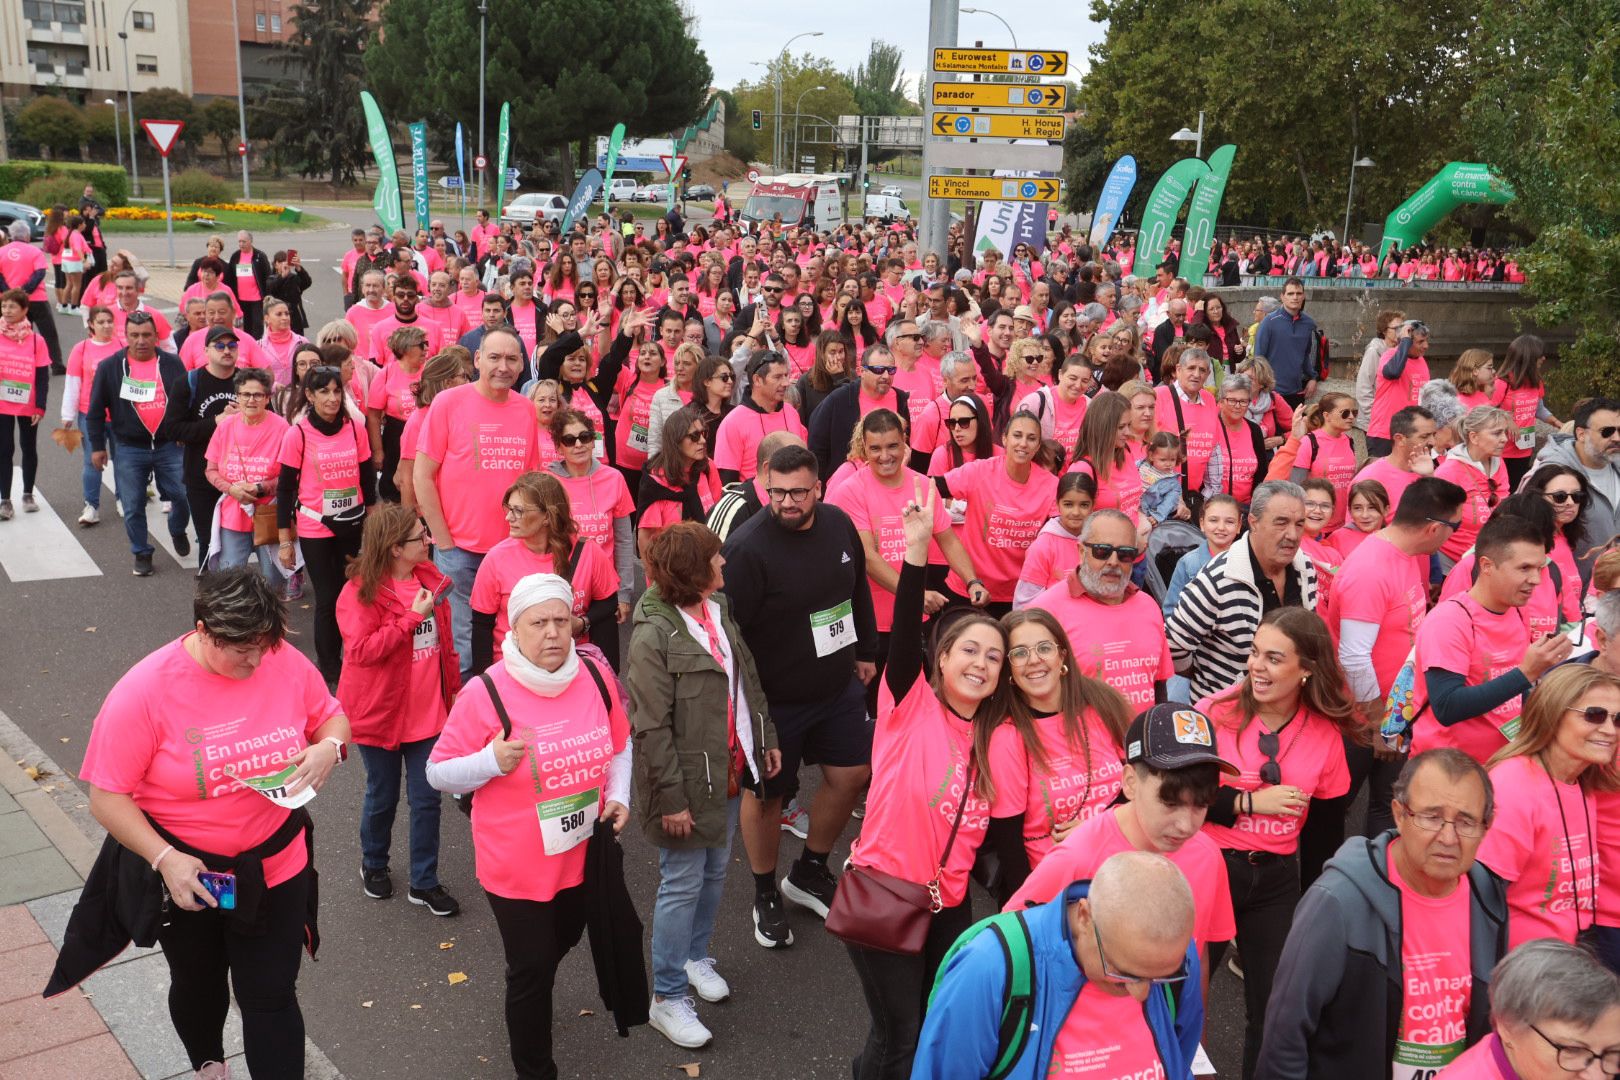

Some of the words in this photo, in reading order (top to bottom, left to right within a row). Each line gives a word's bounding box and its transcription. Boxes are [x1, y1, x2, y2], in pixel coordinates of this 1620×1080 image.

[952, 52, 996, 61] Eurowest
[936, 91, 974, 99] parador
[1036, 128, 1061, 137] Regio
[480, 434, 493, 444] En
[481, 446, 516, 456] contra
[518, 448, 525, 456] el
[332, 498, 352, 508] 5380
[600, 522, 608, 531] el
[990, 513, 1003, 524] En
[1005, 518, 1041, 527] marcha
[881, 528, 892, 537] En
[989, 526, 1026, 537] contra
[881, 539, 907, 549] cont
[830, 620, 844, 637] 579
[1104, 659, 1119, 670] En
[1106, 671, 1148, 687] contra
[205, 744, 231, 761] En
[235, 726, 298, 753] marcha
[538, 741, 558, 755] En
[561, 725, 609, 749] marcha
[210, 750, 283, 781] contra
[287, 740, 302, 758] el
[542, 746, 604, 773] contra
[604, 738, 614, 755] el
[546, 762, 611, 790] cánce
[1049, 777, 1070, 791] En
[1073, 761, 1123, 783] marcha
[561, 810, 584, 832] 580
[1408, 978, 1431, 996] En
[1408, 994, 1465, 1020] contr
